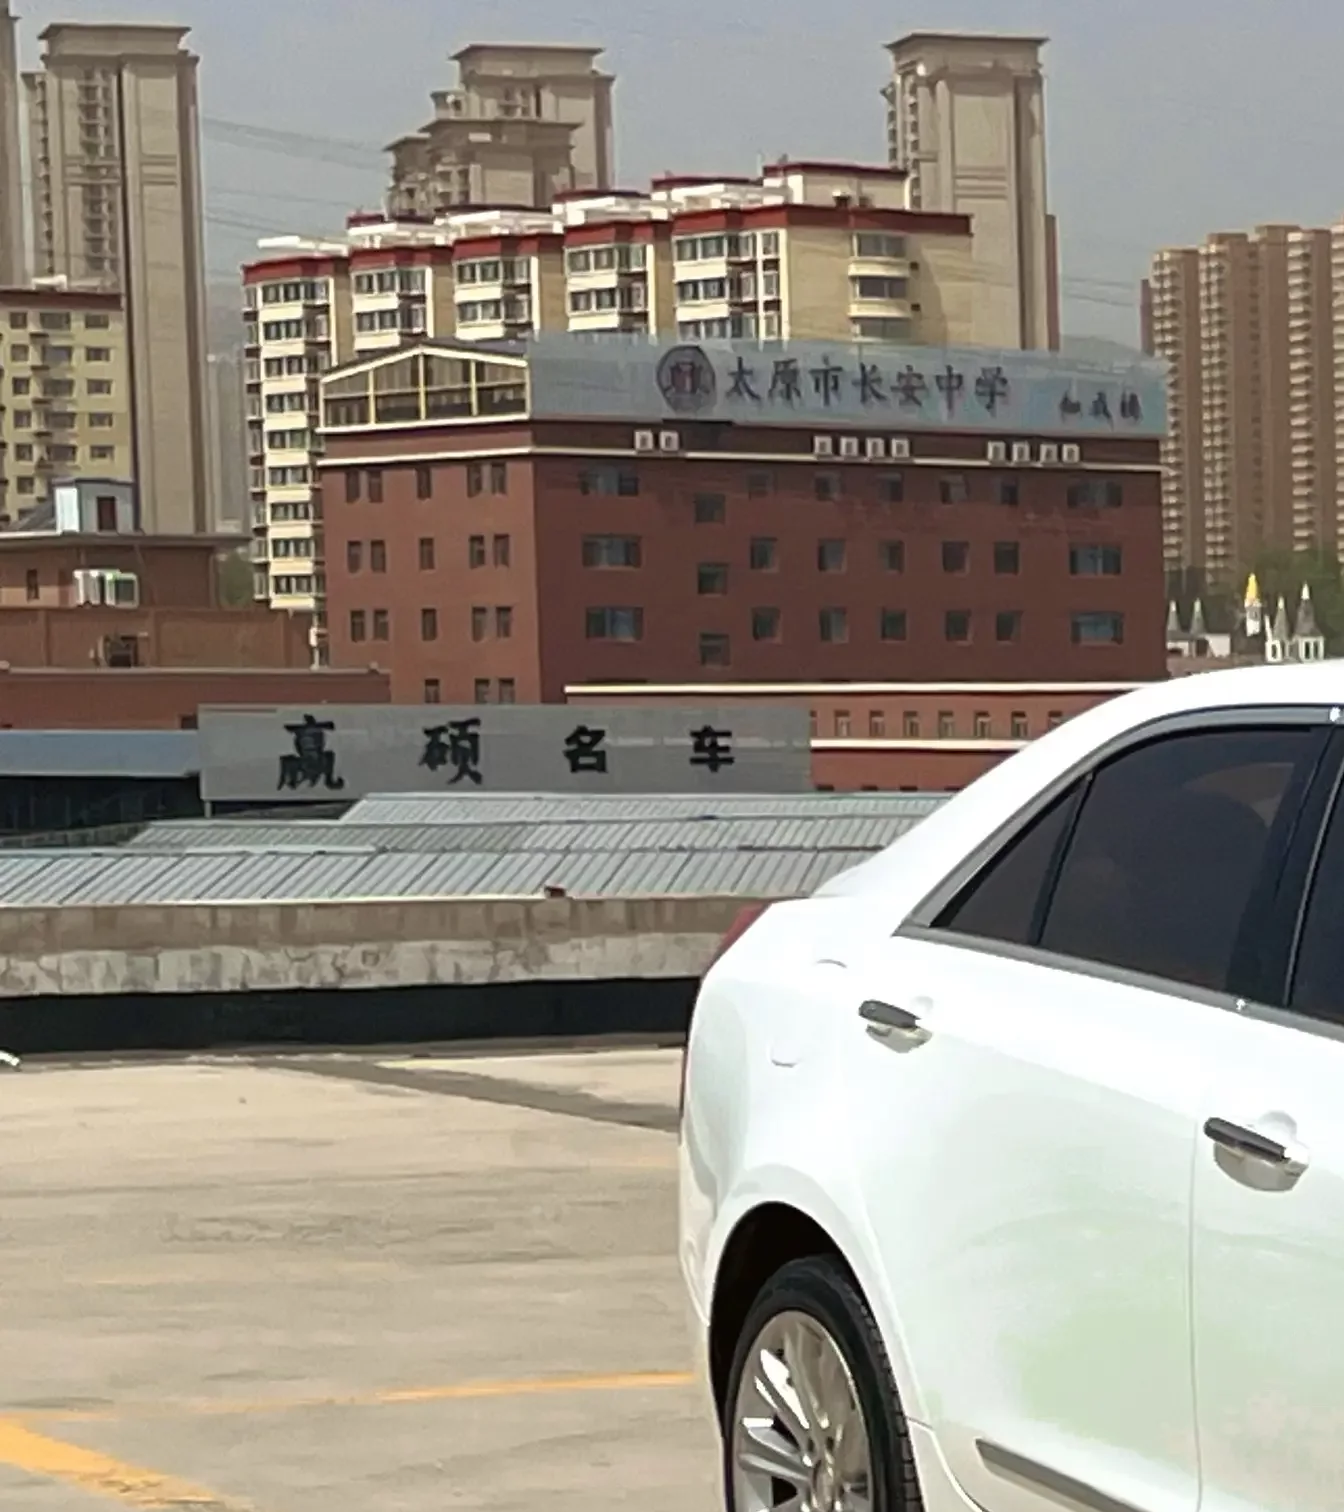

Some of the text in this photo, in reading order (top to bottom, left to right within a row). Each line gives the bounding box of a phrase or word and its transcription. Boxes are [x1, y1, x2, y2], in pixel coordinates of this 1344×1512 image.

[726, 356, 1009, 412] 太原市长安中学
[277, 713, 735, 791] 赢硕名车
